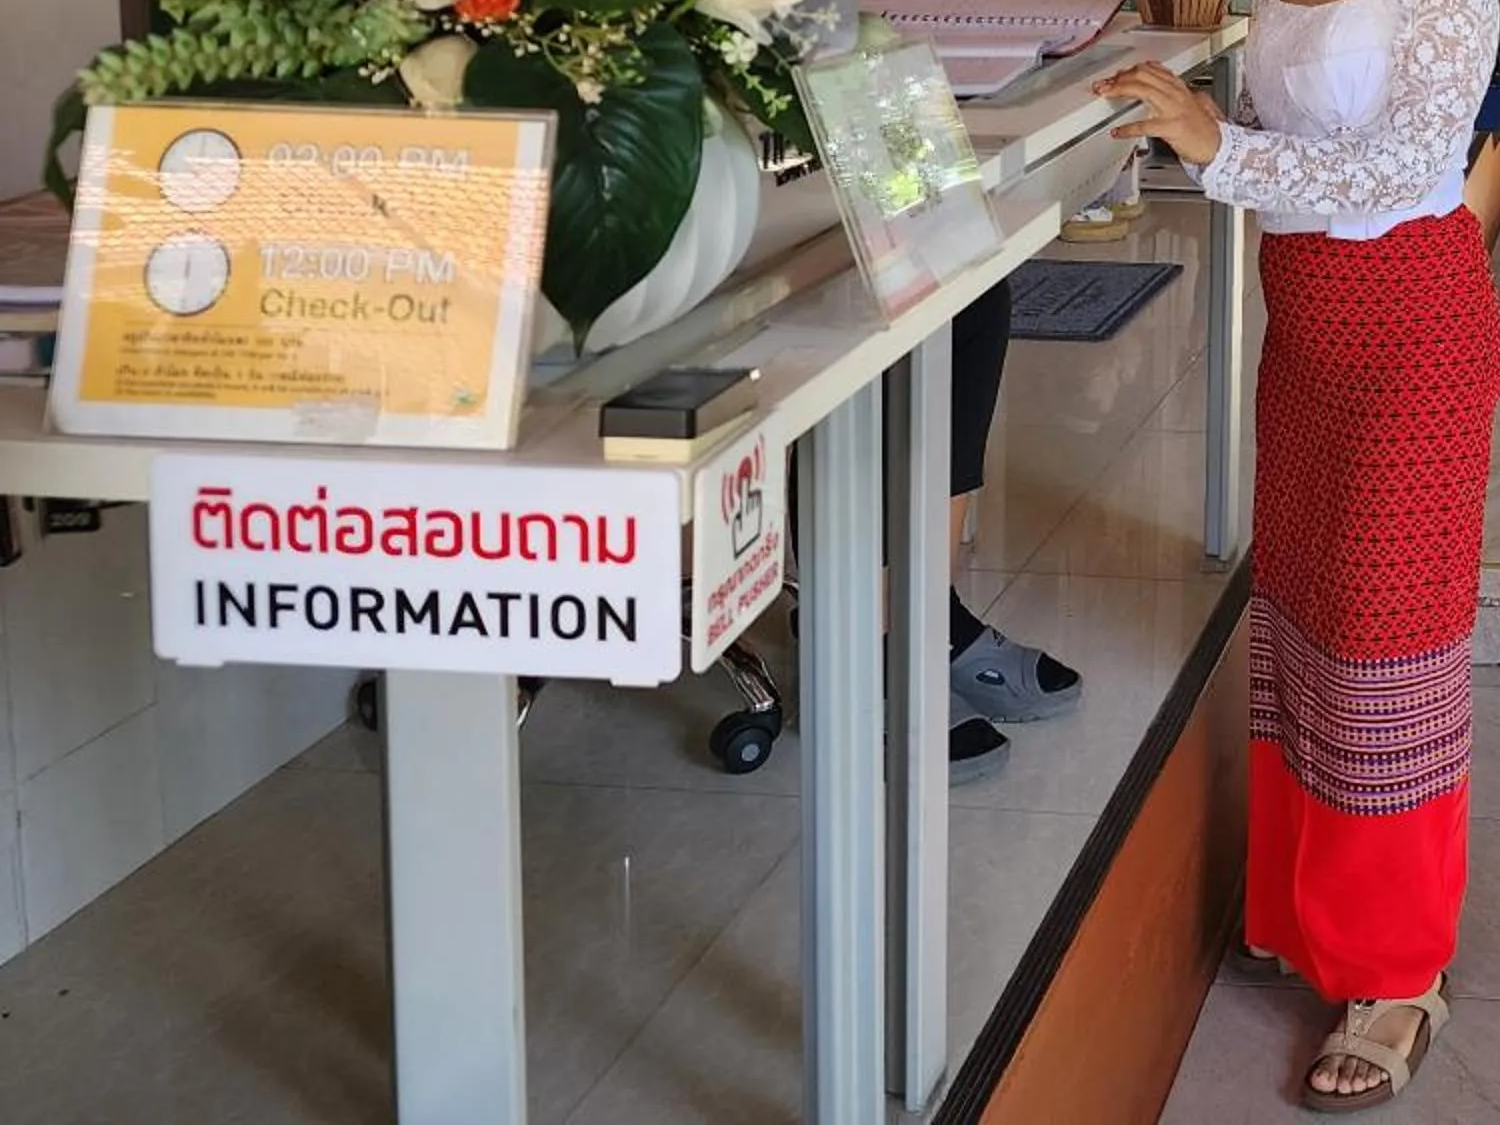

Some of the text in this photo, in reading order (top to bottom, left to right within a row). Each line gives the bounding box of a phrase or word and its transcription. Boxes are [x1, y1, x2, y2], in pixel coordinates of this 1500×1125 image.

[260, 242, 458, 285] 12:00 PM
[259, 286, 453, 324] Check-Out
[190, 485, 639, 566] ติดต่อสอบถาม
[195, 579, 639, 645] INFORMATION
